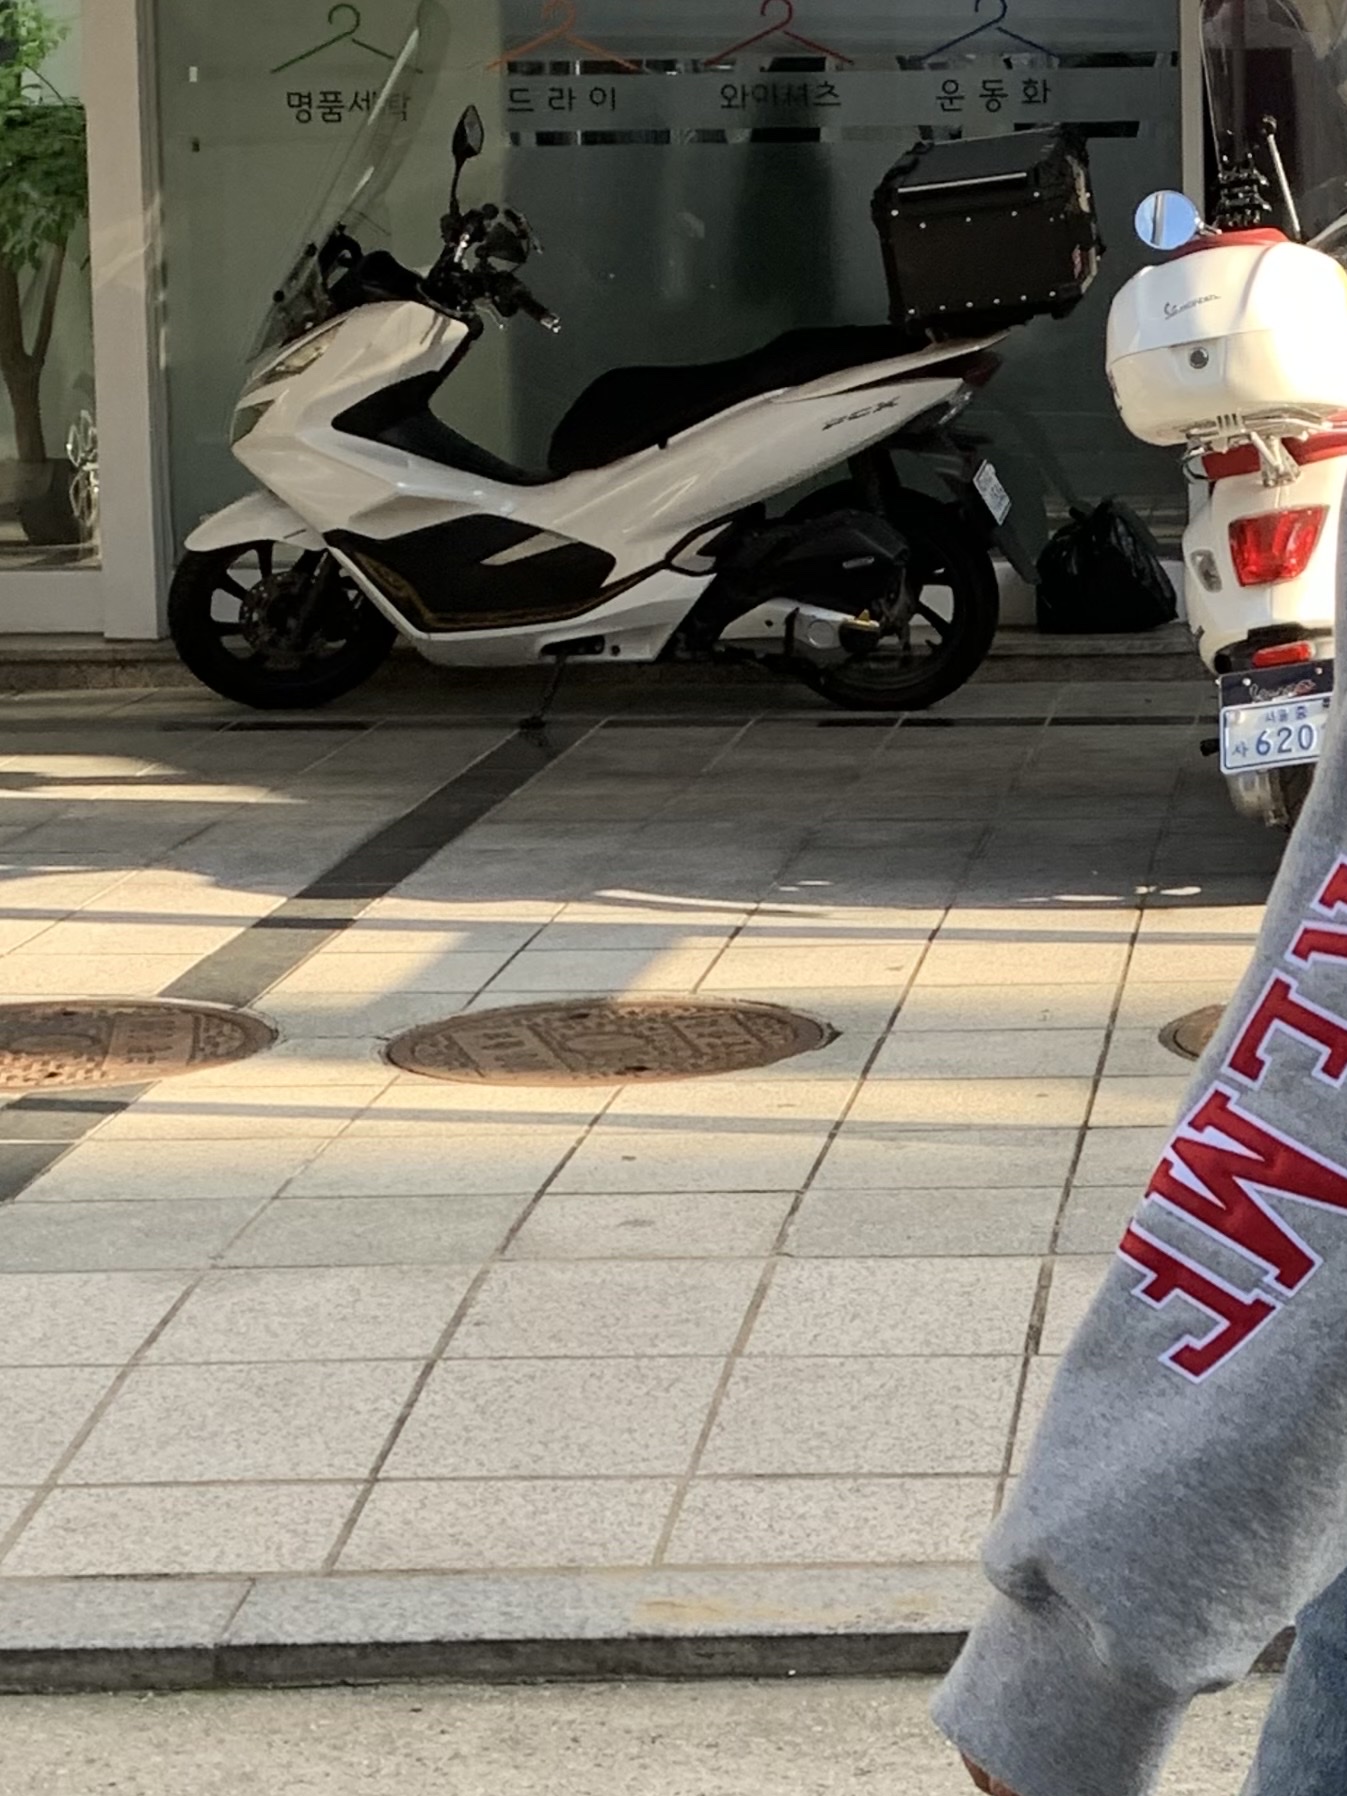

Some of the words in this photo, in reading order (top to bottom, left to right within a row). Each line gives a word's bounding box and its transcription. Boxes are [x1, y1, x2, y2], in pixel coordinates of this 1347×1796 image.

[507, 87, 617, 112] 드라이
[935, 78, 1052, 113] 운동화
[1256, 724, 1325, 756] 620
